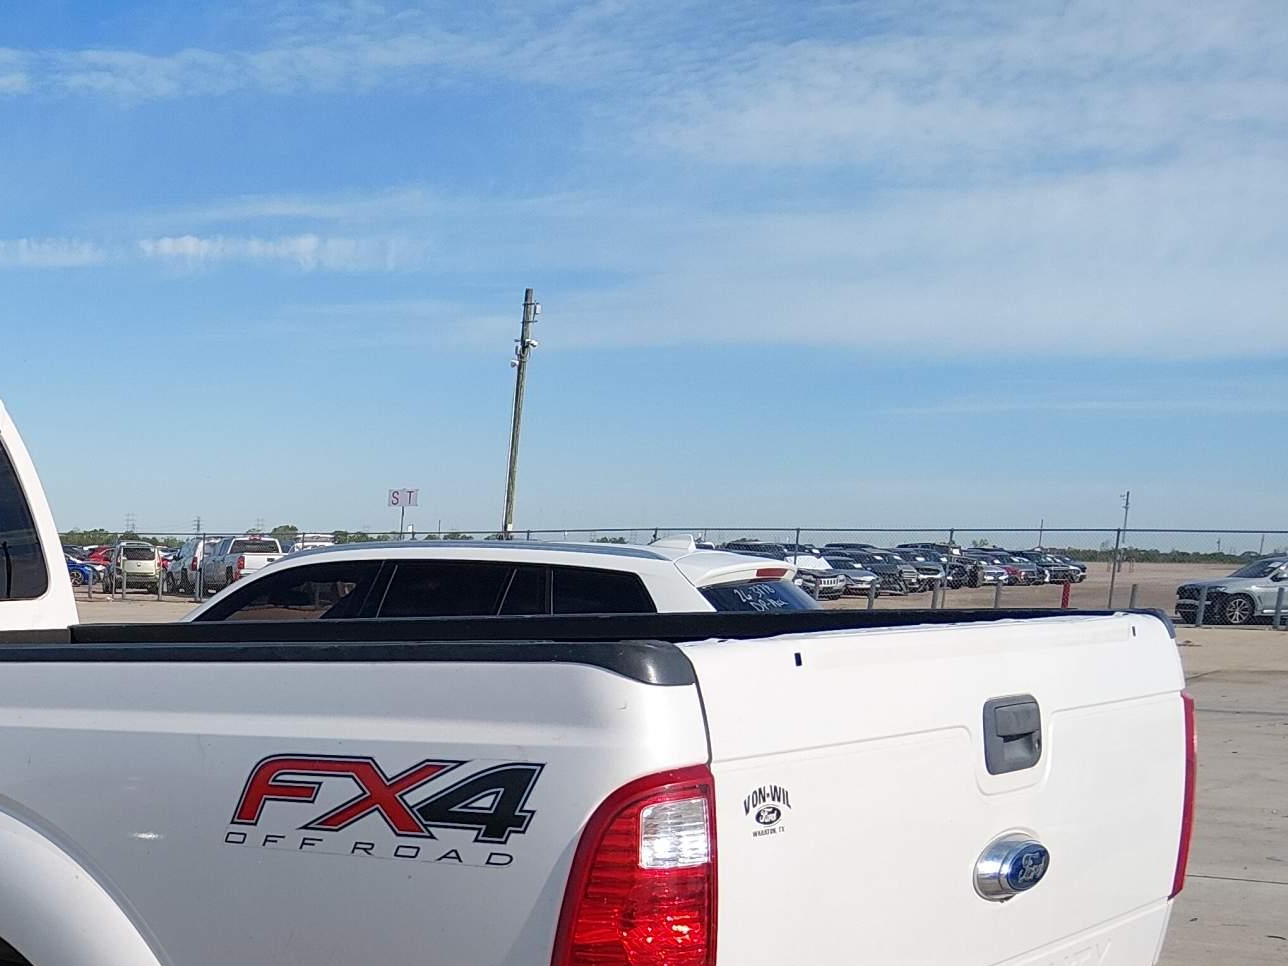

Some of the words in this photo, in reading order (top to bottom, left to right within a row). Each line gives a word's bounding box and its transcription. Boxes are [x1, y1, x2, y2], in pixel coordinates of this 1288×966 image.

[230, 753, 546, 845] FX4
[224, 831, 323, 851] OFF
[351, 841, 515, 866] ROAD
